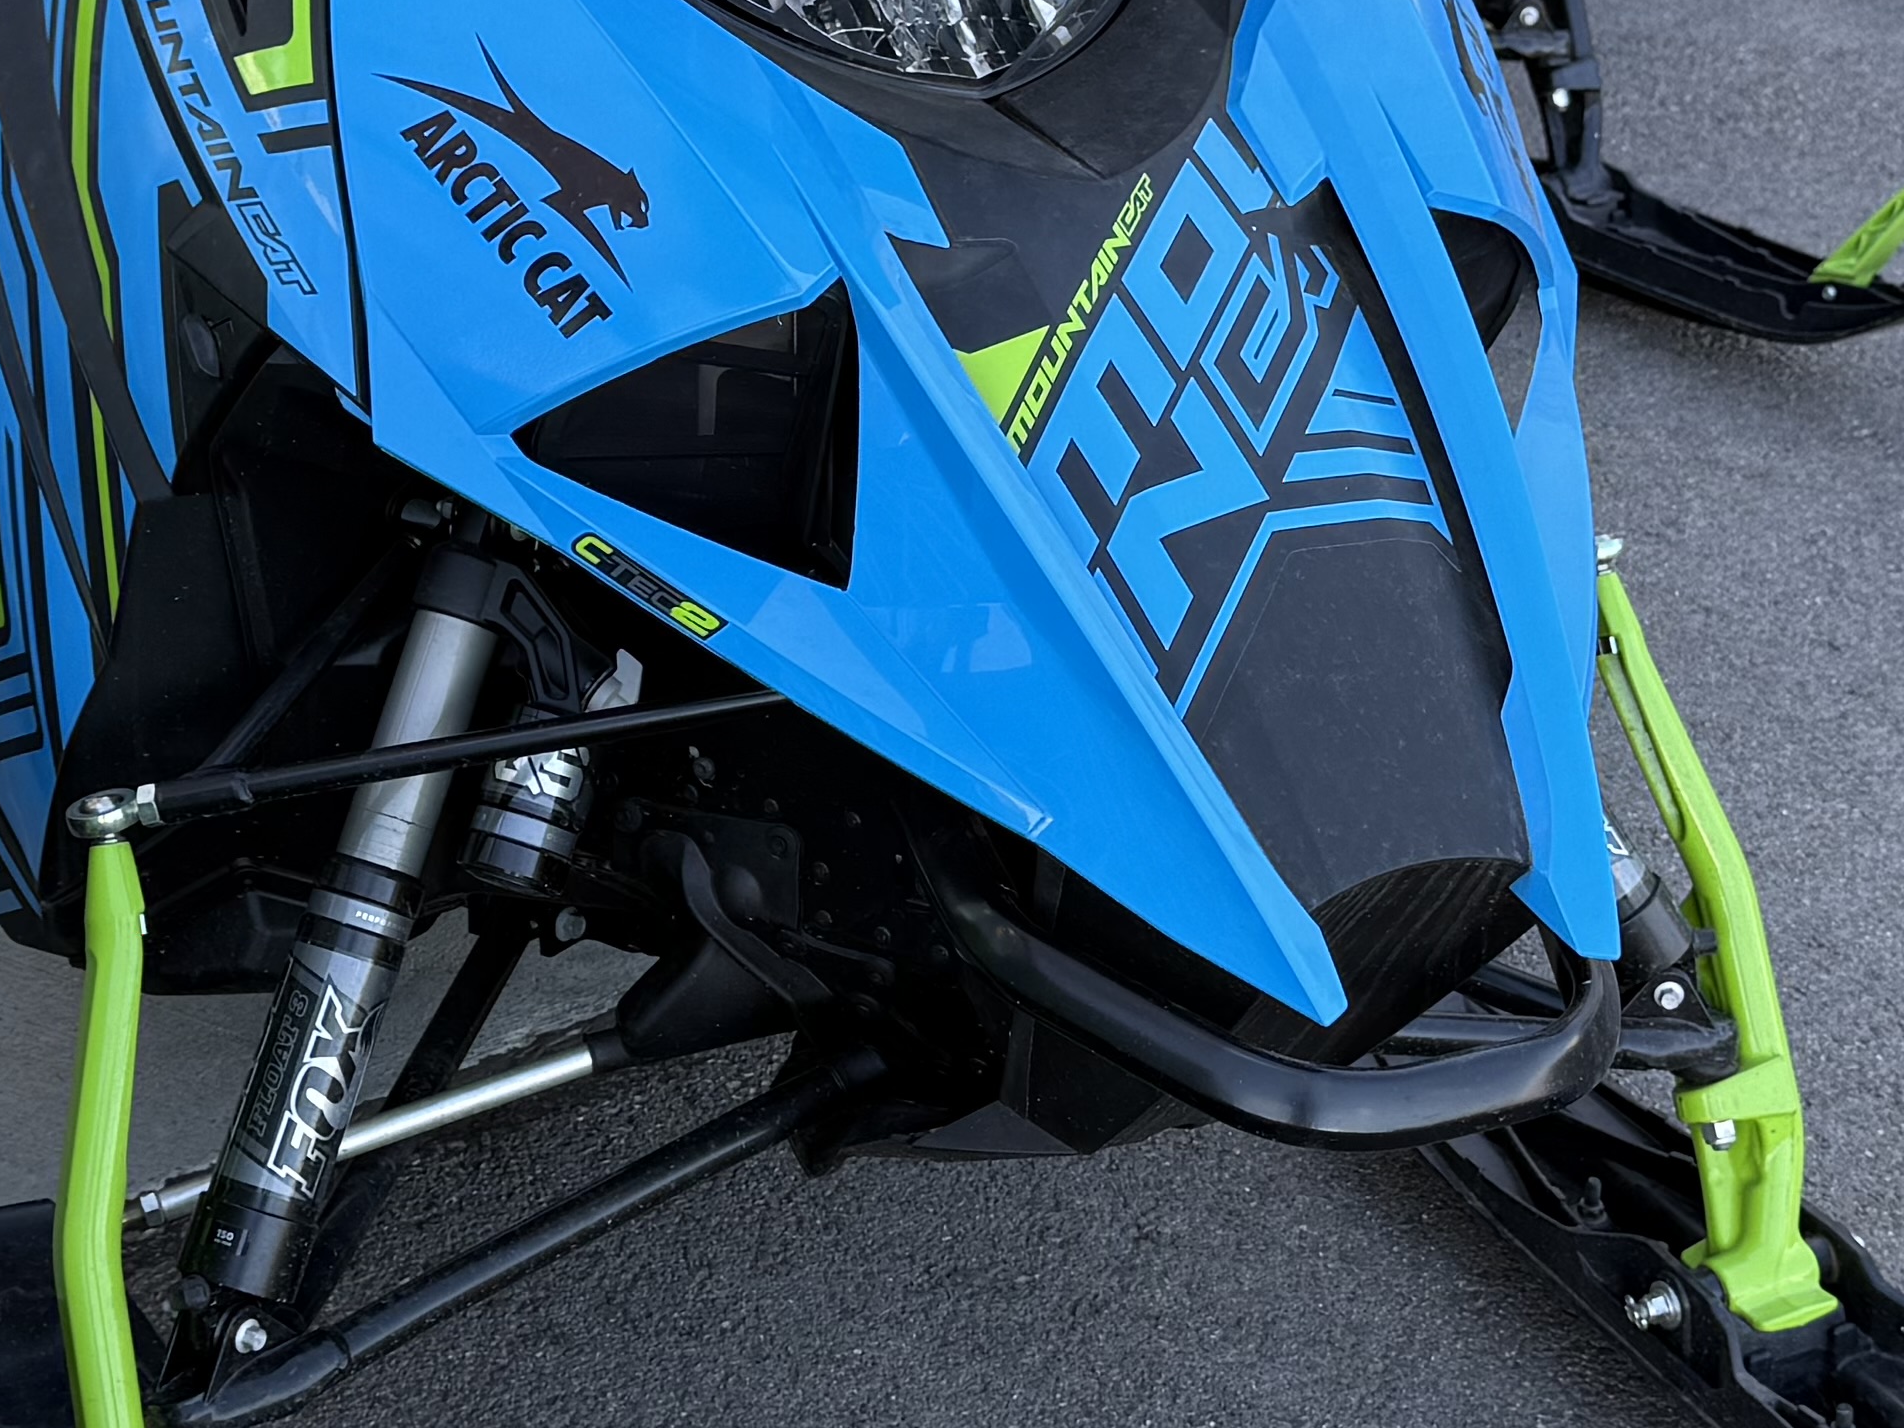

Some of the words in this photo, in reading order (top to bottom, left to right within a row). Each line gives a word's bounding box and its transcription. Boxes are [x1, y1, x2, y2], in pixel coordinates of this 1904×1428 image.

[399, 109, 547, 265] ARCTIC
[523, 237, 614, 340] CAT
[247, 1012, 299, 1138] FLOAT
[290, 988, 310, 1018] 3
[266, 983, 364, 1200] FOX
